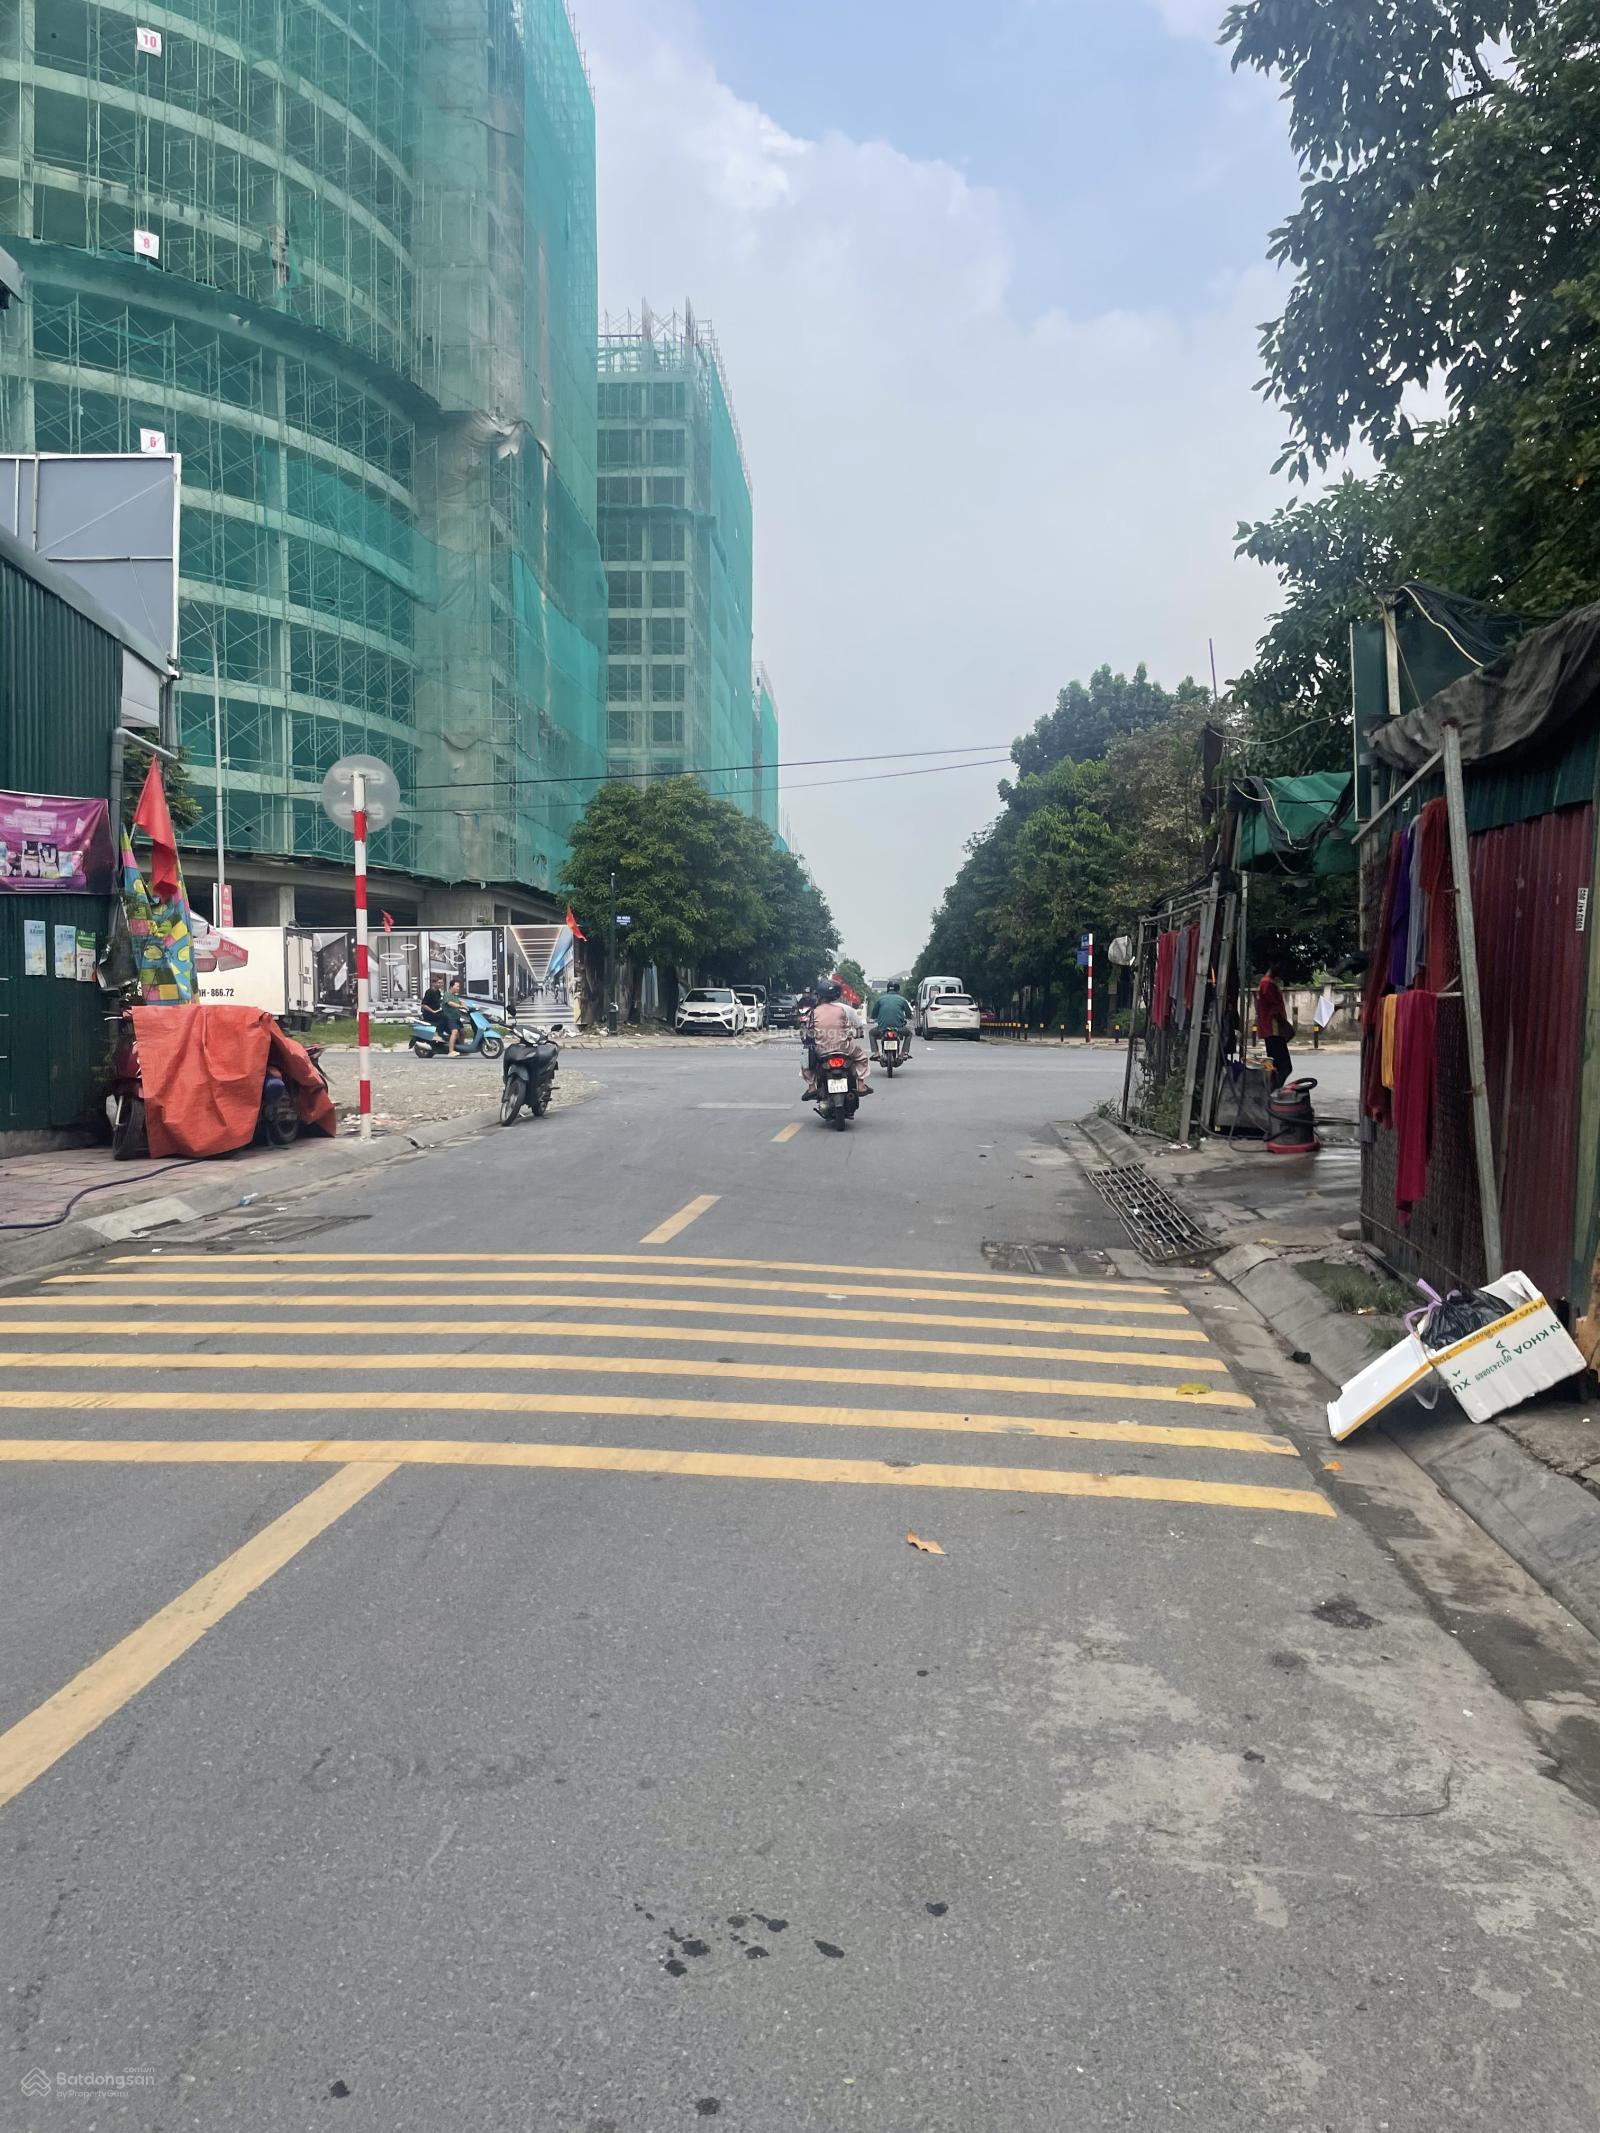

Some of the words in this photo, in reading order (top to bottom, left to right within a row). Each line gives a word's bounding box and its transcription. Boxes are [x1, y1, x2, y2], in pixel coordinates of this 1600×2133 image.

[143, 34, 157, 48] 10
[143, 238, 150, 249] 8
[149, 436, 157, 448] 6
[1513, 1329, 1550, 1354] KHOA
